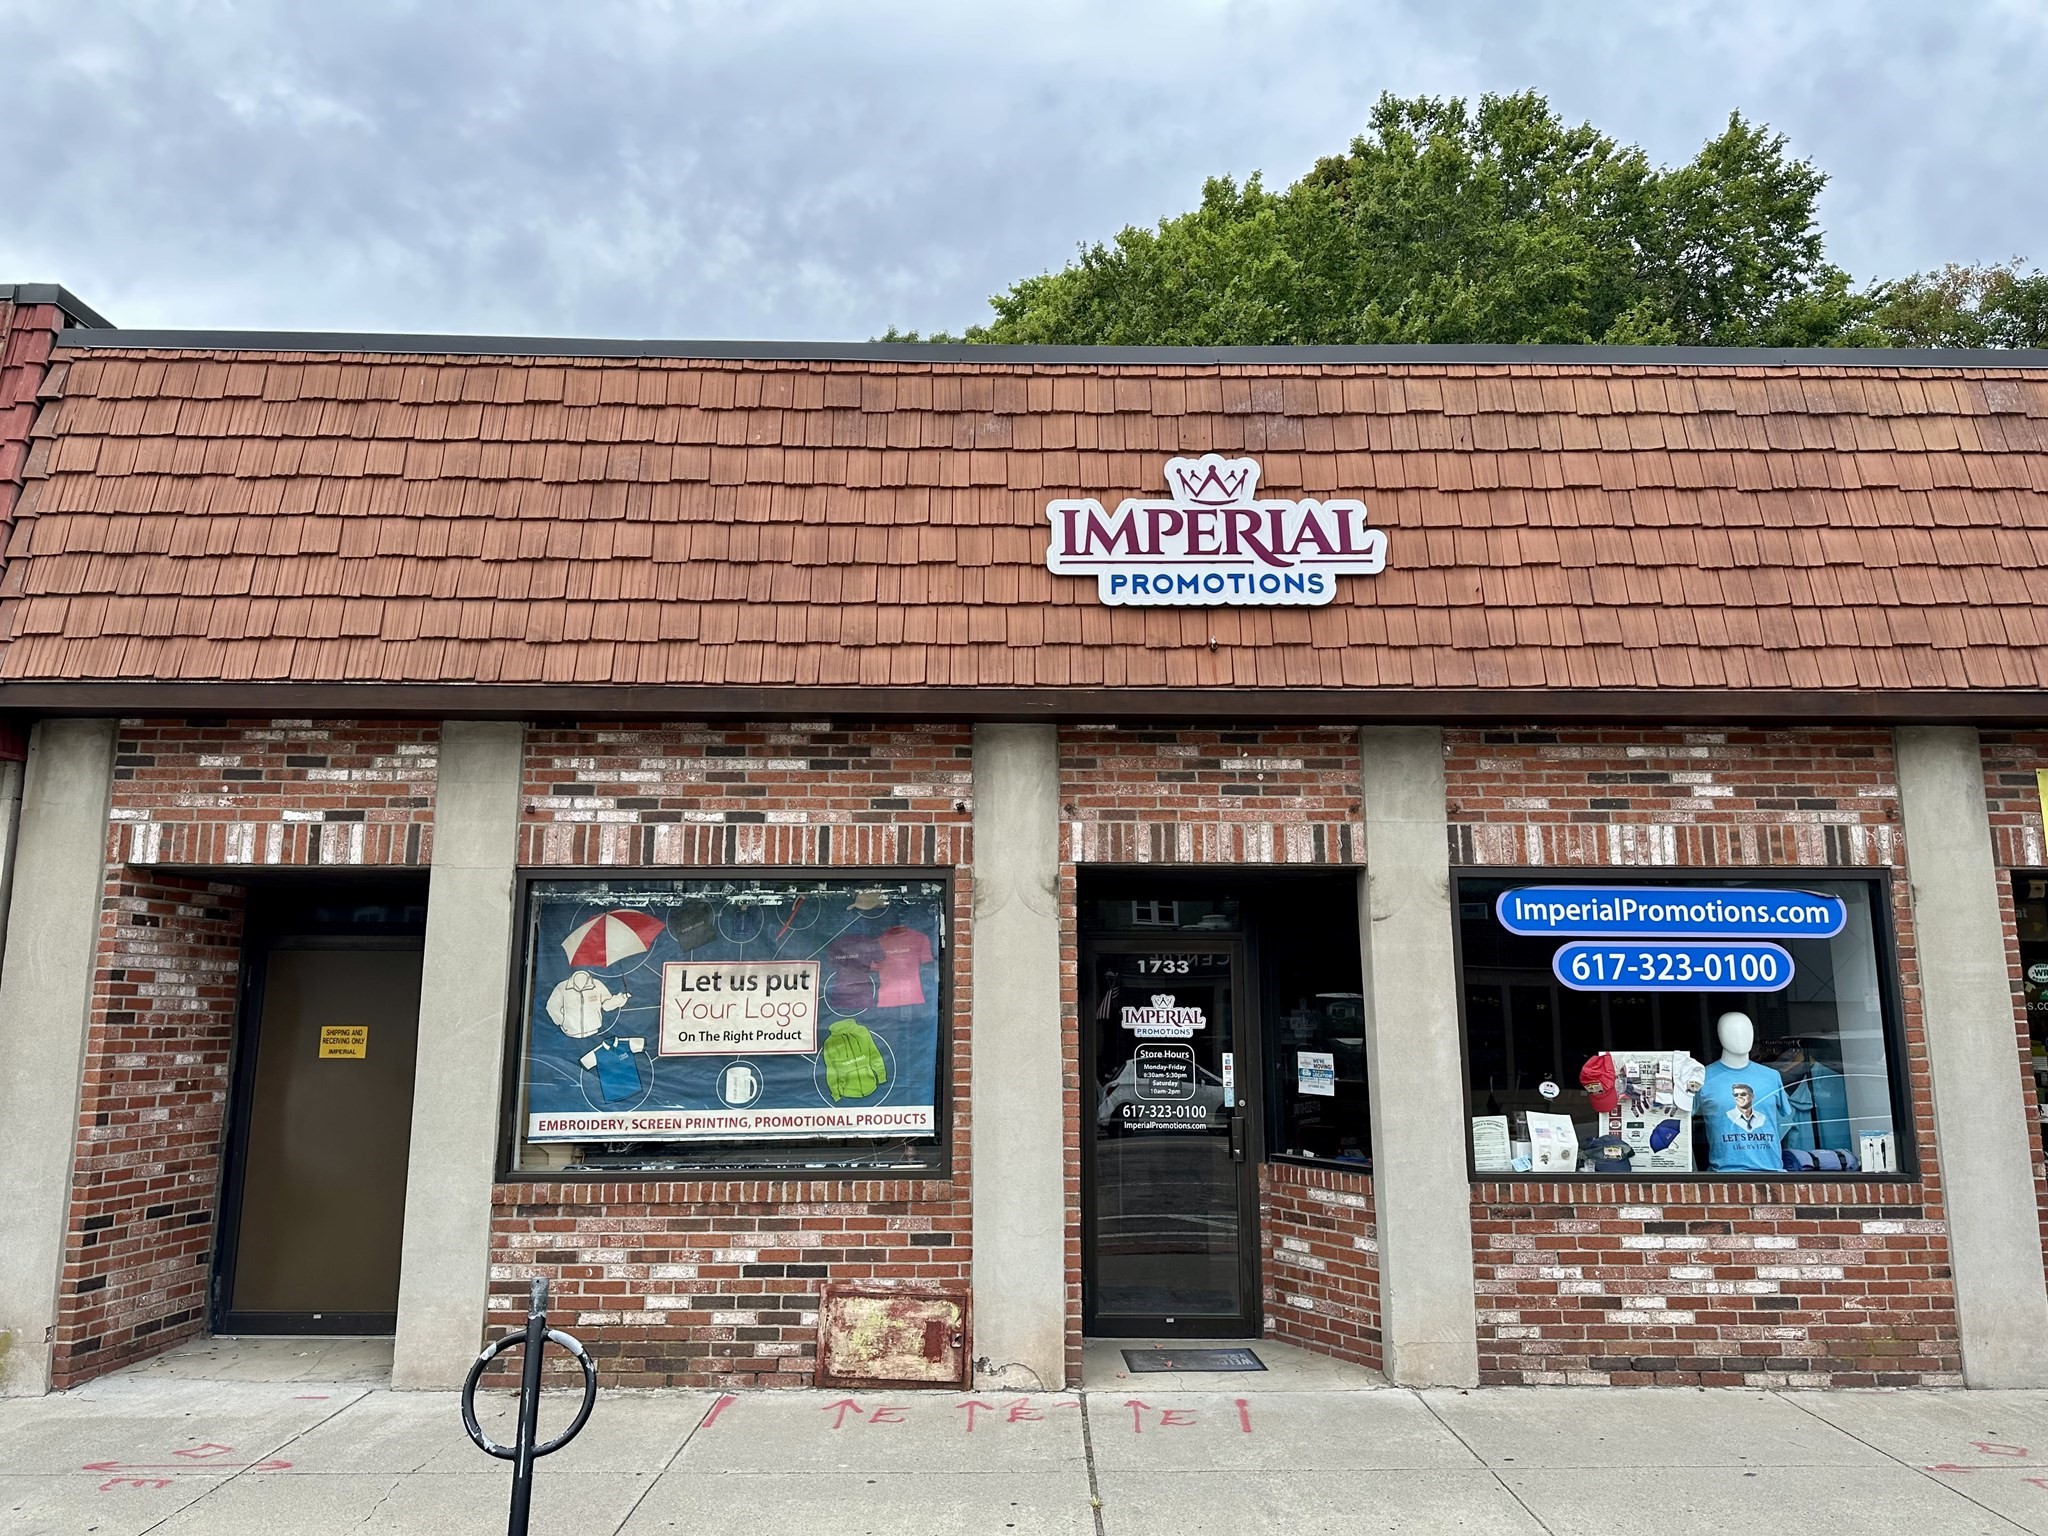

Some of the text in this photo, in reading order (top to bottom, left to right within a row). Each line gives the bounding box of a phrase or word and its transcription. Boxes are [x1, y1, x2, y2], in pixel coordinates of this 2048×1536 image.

[1060, 508, 1374, 568] IMPERIAL
[1111, 573, 1324, 595] PROMOTIONS
[1515, 898, 1830, 926] ImperialPromotions.com
[1137, 960, 1189, 974] 1733
[1571, 953, 1778, 982] 617-323-0100
[681, 970, 810, 997] Let us put
[674, 997, 807, 1027] Your Logo
[1125, 1009, 1204, 1027] IMPERIAL
[678, 1029, 802, 1044] On The Right Product
[1137, 1028, 1190, 1036] PROMOTIONS
[322, 1037, 366, 1045] RECEIVING ONLY
[1140, 1050, 1190, 1058] Store Hours
[1122, 1105, 1207, 1118] 617-323-0100
[538, 1113, 927, 1131] EMBROIDERY, SCREEN PRINTING, PROMOTIONAL PRODUCTS
[1124, 1121, 1207, 1130] ImperialPromotions.com
[1722, 1134, 1774, 1142] LET'S PARTY
